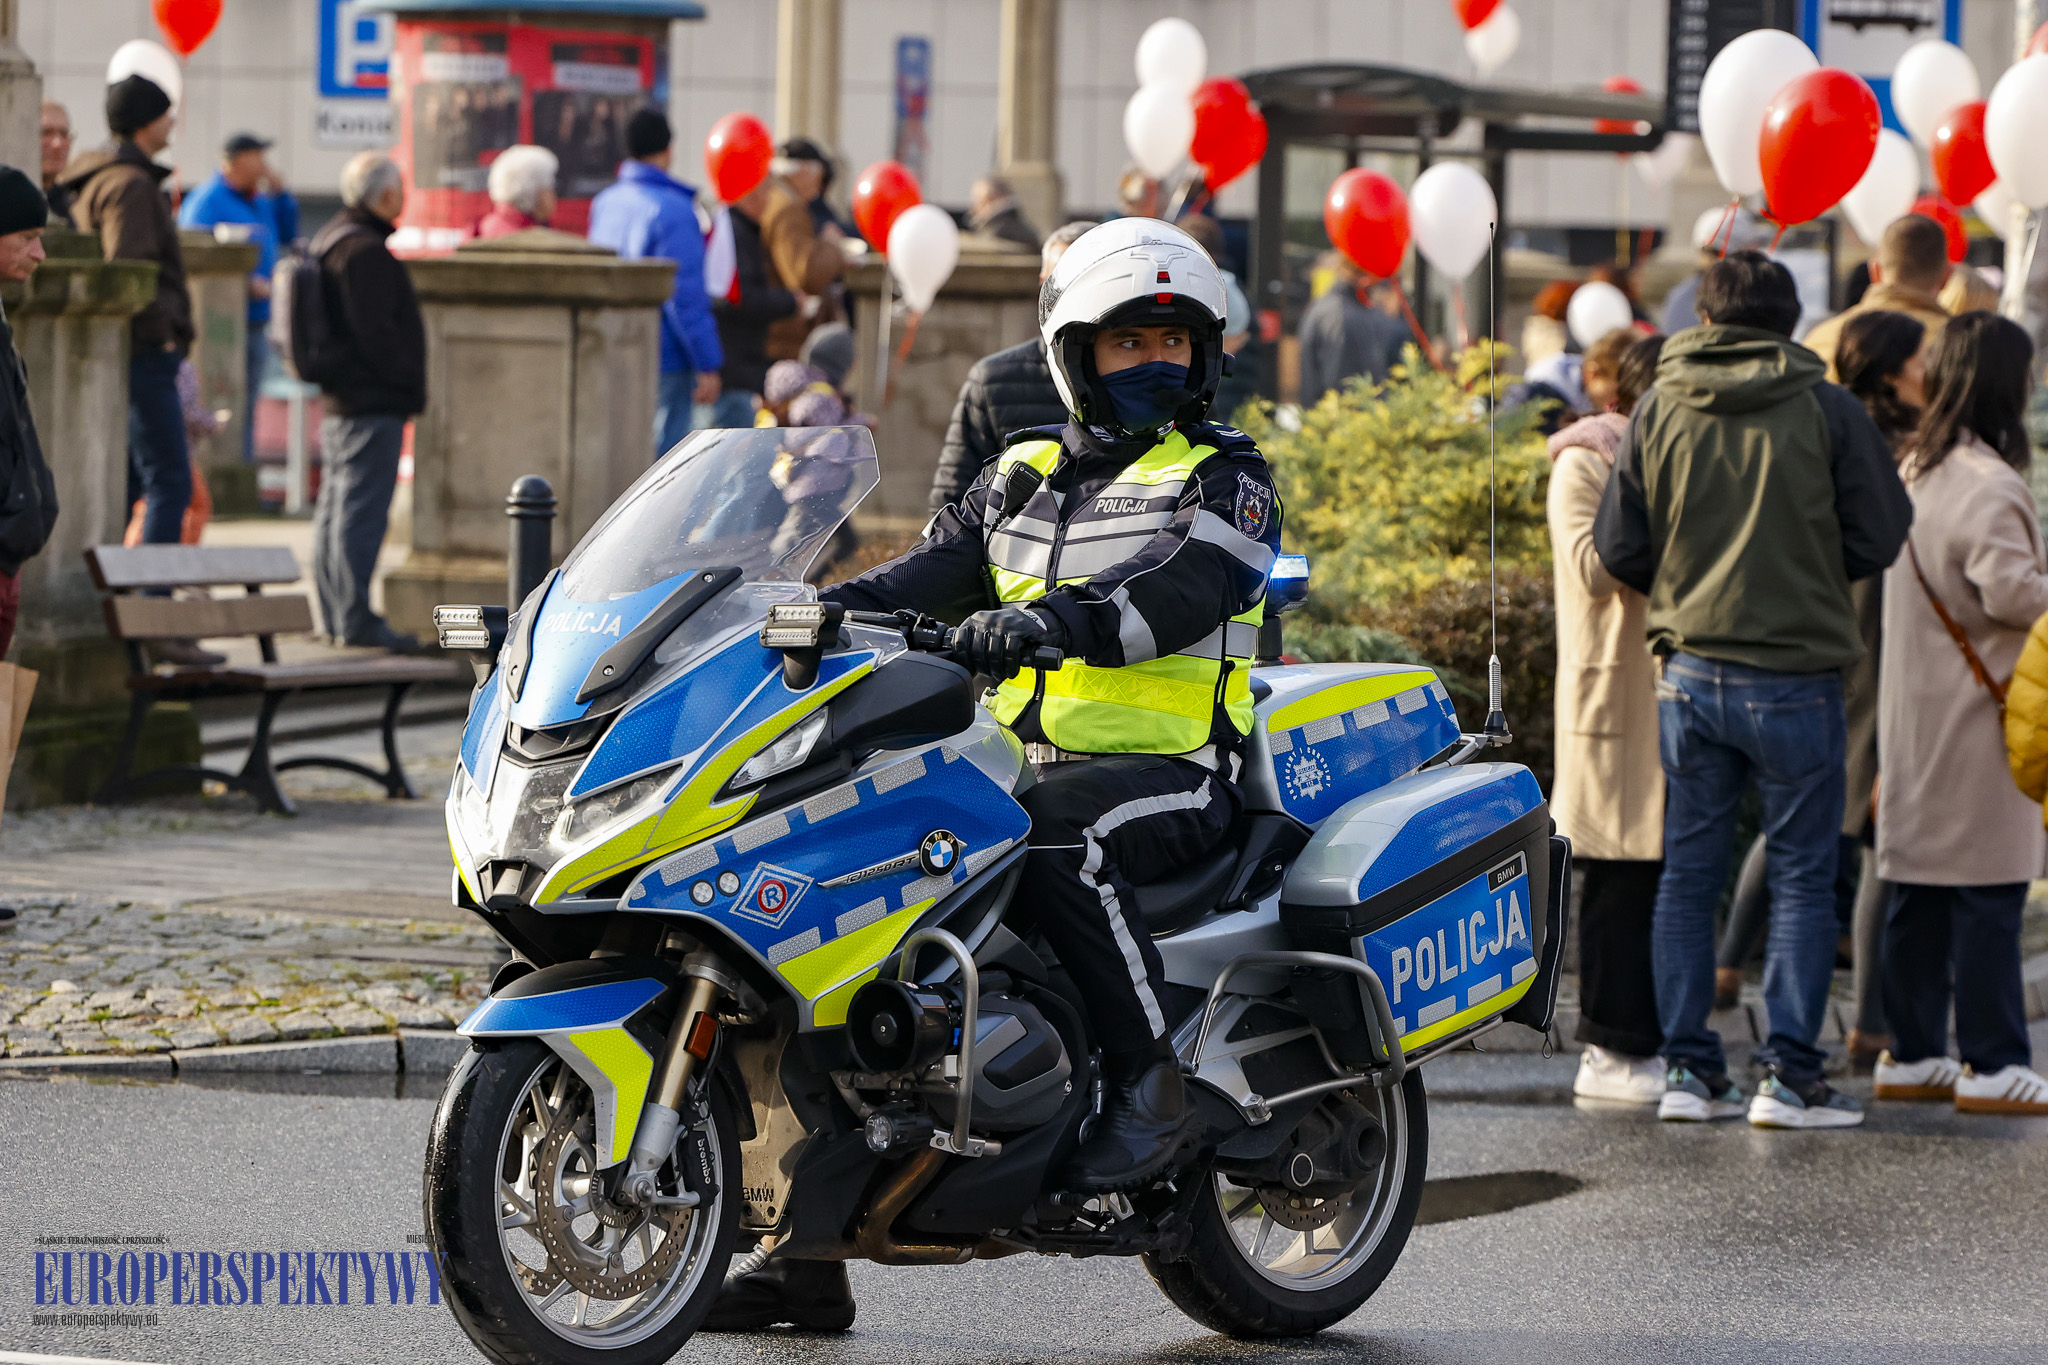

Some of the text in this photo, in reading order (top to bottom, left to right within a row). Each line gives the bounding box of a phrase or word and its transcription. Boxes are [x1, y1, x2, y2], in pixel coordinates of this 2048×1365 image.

[1241, 476, 1270, 500] POLICJA
[1093, 498, 1149, 513] POLICJA
[540, 611, 622, 637] POLICJA
[924, 832, 955, 851] BMW
[1497, 864, 1515, 883] BMW
[764, 887, 781, 907] R
[1391, 890, 1526, 1004] POLICJA
[697, 1138, 711, 1185] brembo
[742, 1187, 774, 1202] BMW
